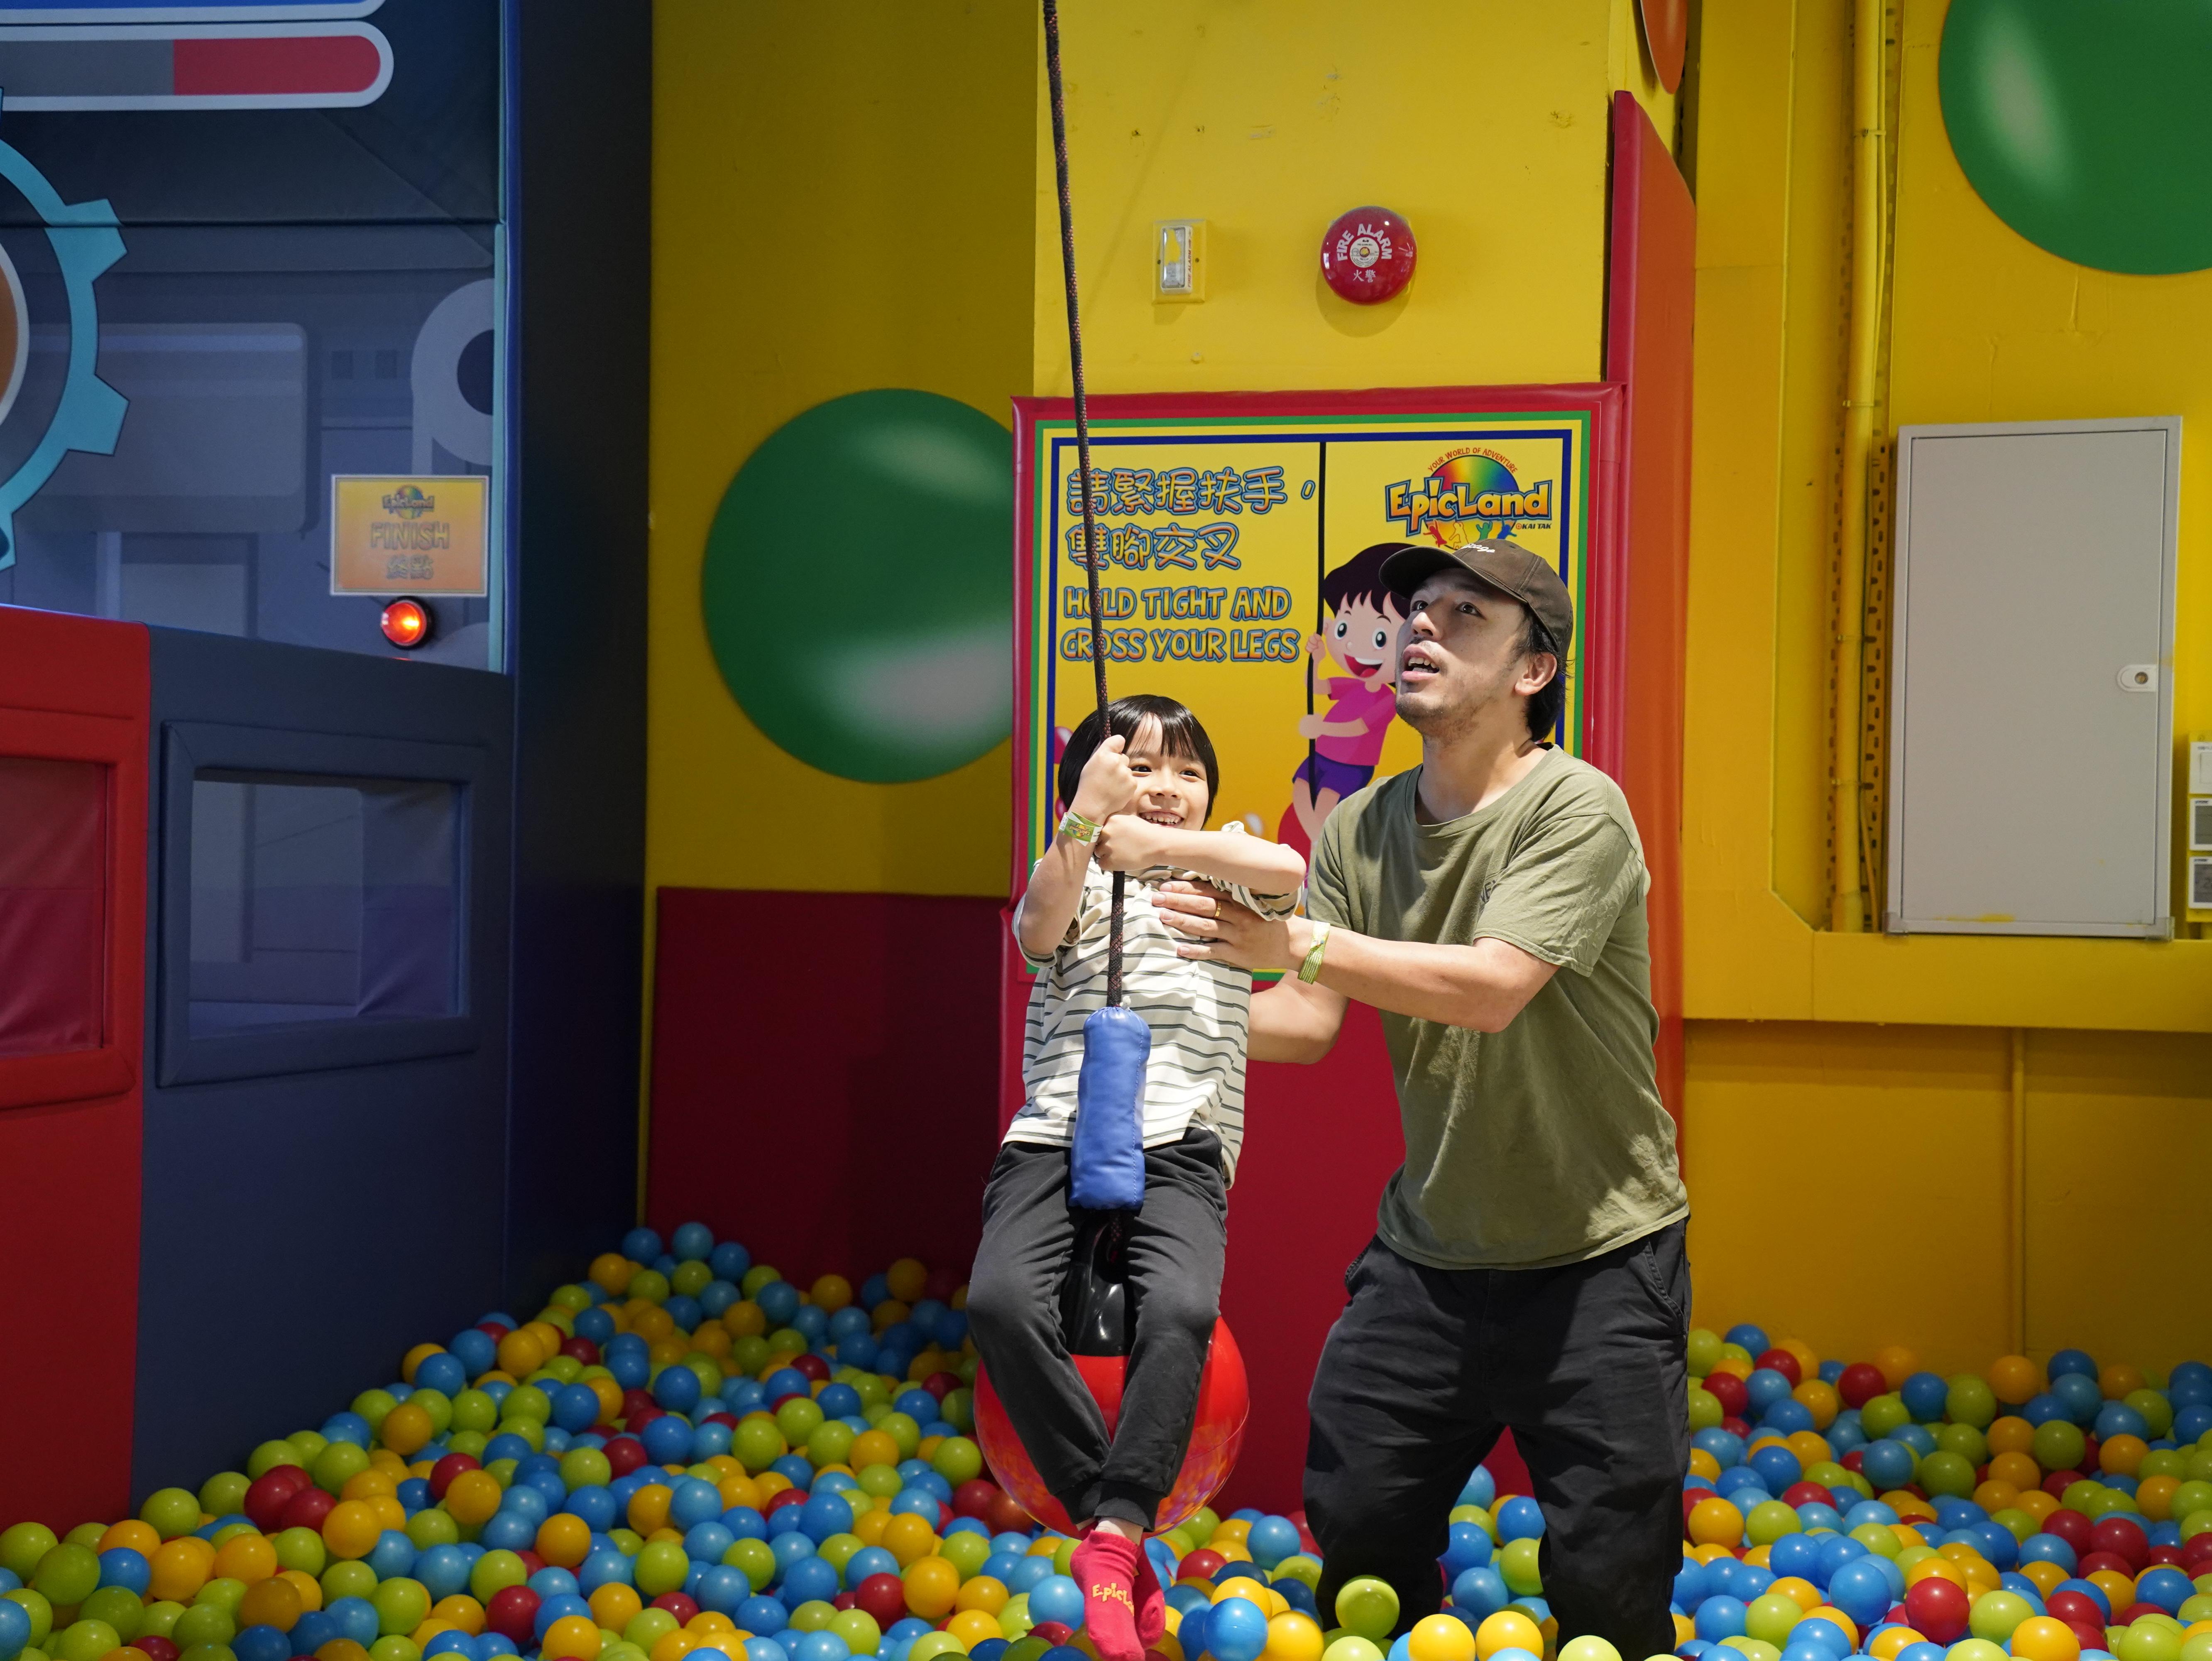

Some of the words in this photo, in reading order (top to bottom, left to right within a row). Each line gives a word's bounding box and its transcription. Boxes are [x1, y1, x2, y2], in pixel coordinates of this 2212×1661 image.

[1336, 230, 1354, 261] FIRE
[1357, 223, 1392, 259] ALARM
[1353, 269, 1376, 283] 火警
[1428, 456, 1445, 472] YOUR
[1445, 447, 1470, 460] WORLD
[1483, 448, 1518, 474] ADVENTURE
[1385, 476, 1553, 537] EpicLand
[370, 521, 450, 550] FINISH
[1142, 586, 1227, 620] TIGHT
[1230, 586, 1292, 621] AND
[1150, 628, 1227, 662] YOUR
[1230, 628, 1301, 663] LEGS
